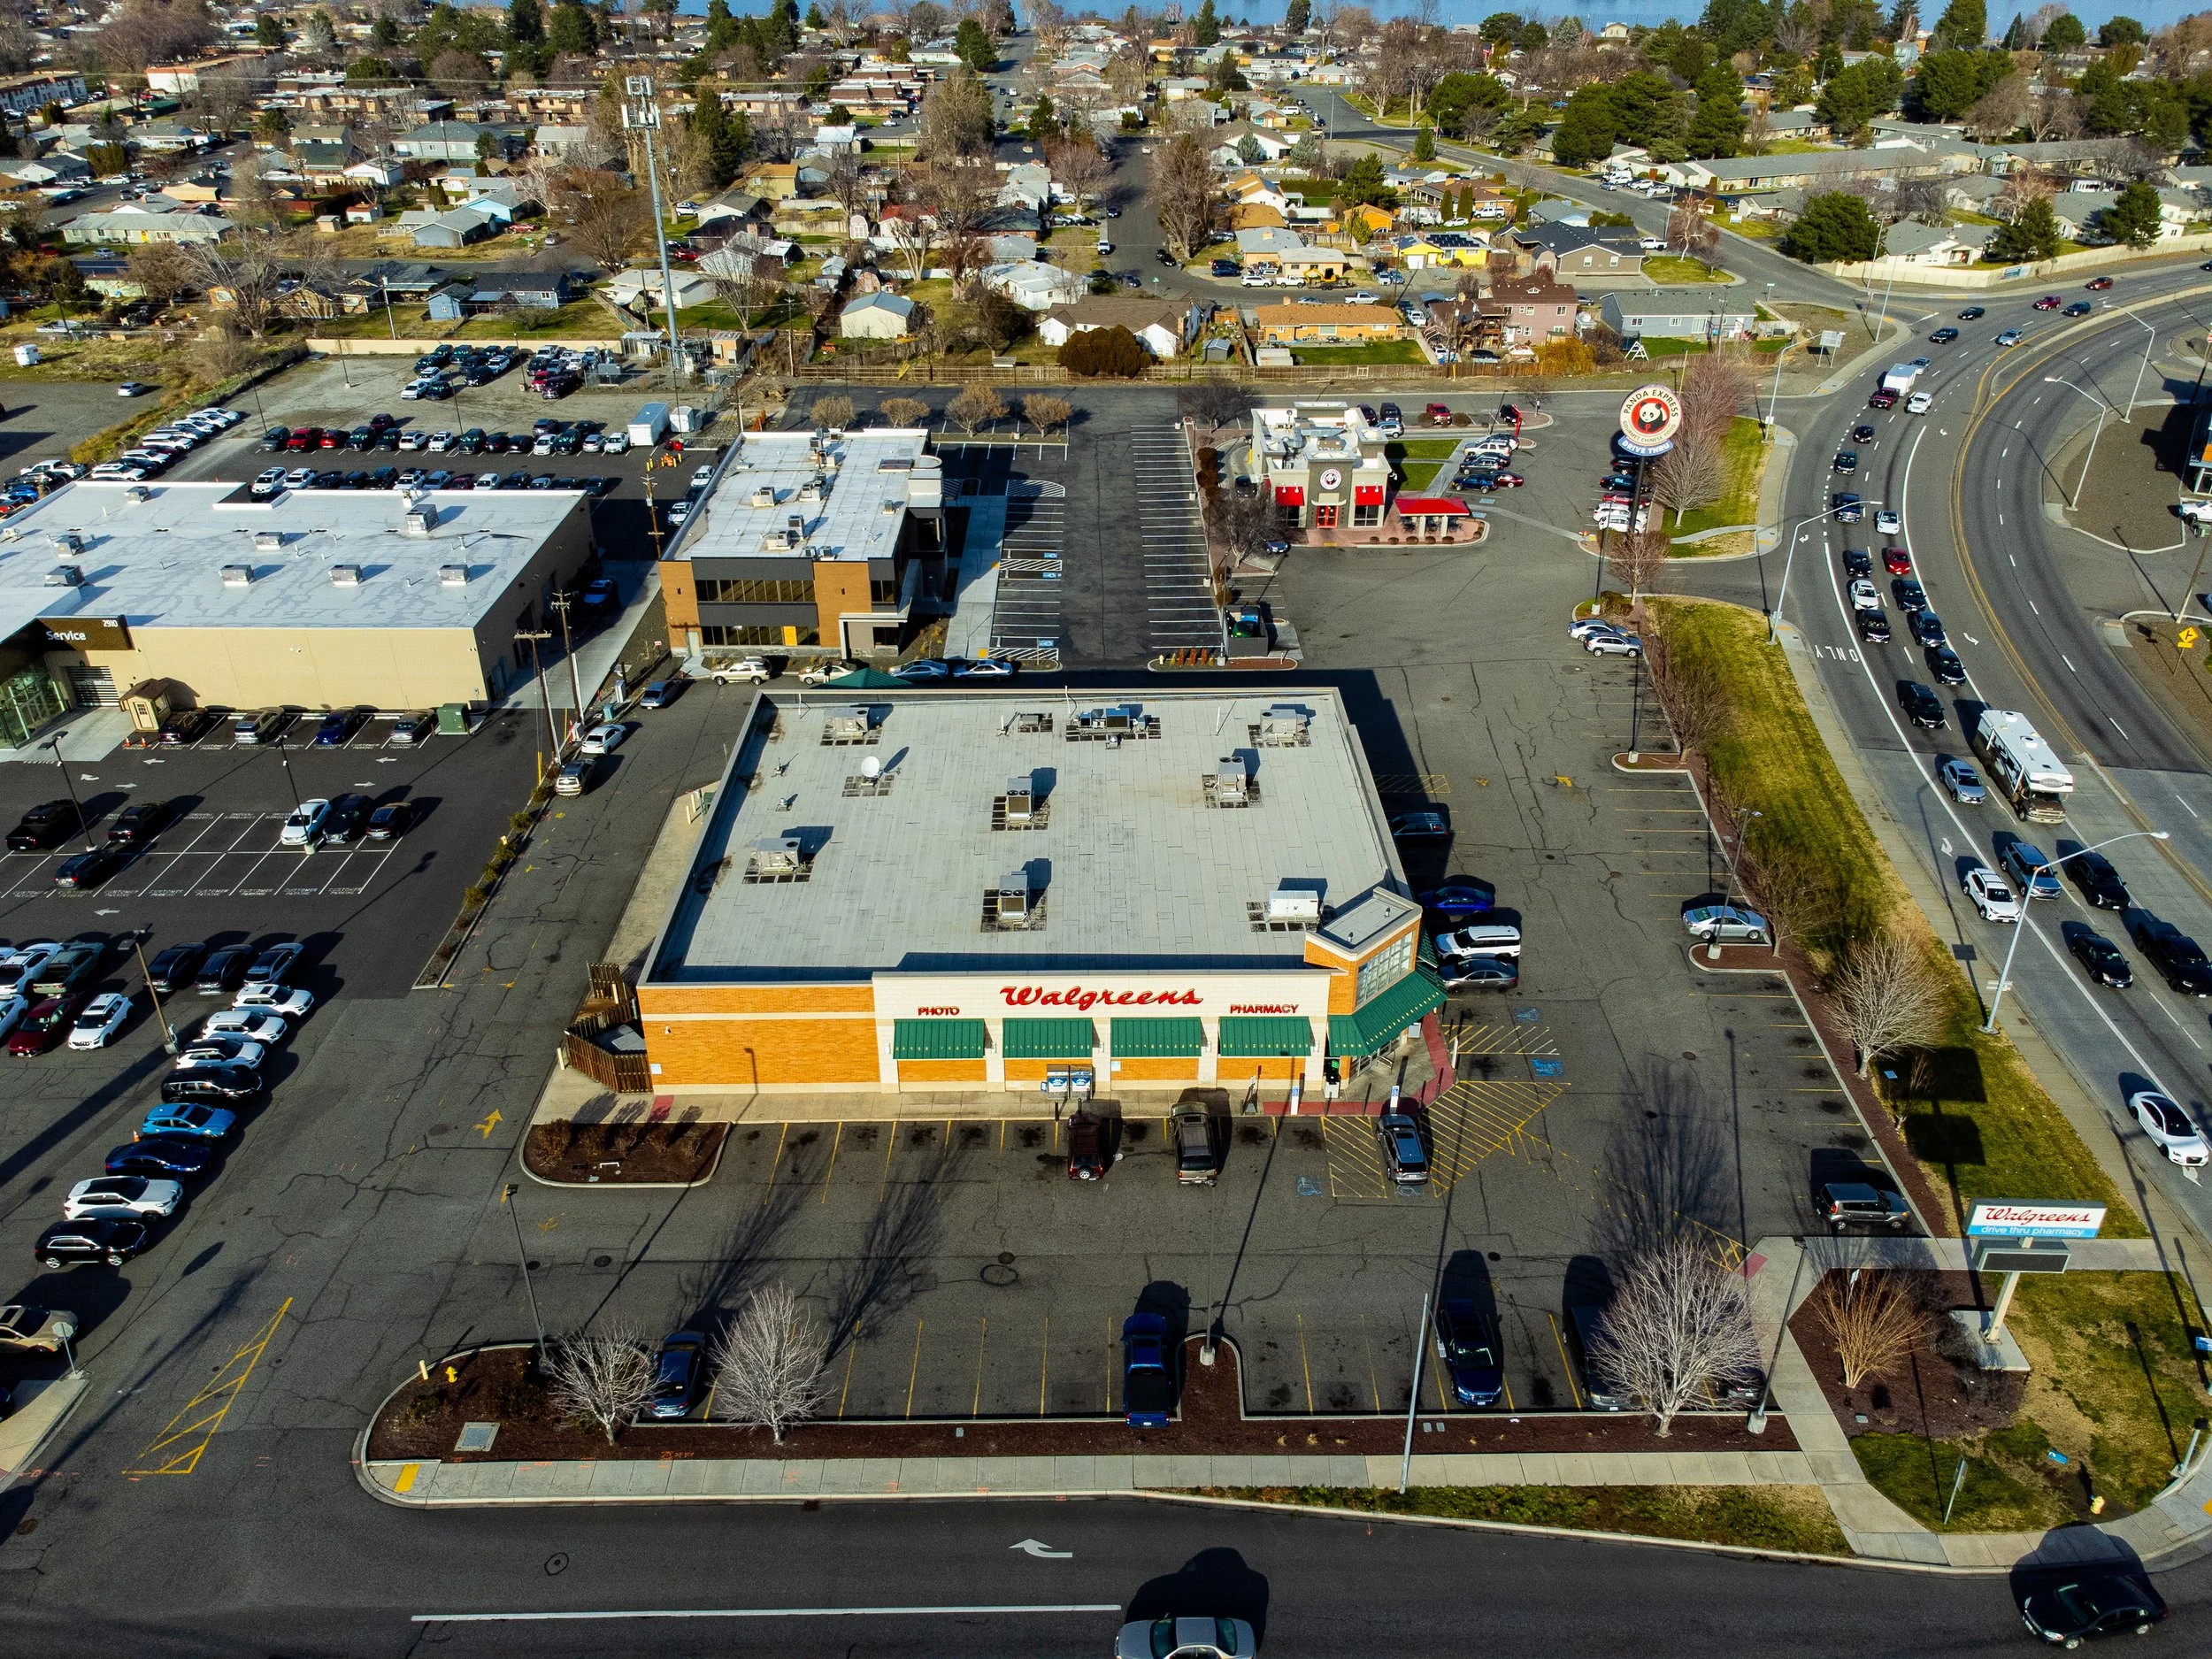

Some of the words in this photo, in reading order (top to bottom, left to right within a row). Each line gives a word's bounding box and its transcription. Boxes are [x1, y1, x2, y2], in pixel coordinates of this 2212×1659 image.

[1624, 390, 1648, 414] PANDA
[1652, 389, 1678, 418] EXPRESS
[1623, 420, 1640, 441] GOURMET
[1663, 423, 1676, 436] FOOD
[1622, 440, 1646, 454] DRIVE
[1648, 442, 1671, 454] THRU
[46, 630, 87, 641] Service
[1814, 644, 1859, 662] ONLY
[999, 985, 1204, 1012] Walgreens
[918, 1005, 960, 1017] PHOTO
[1229, 1002, 1299, 1015] PHARMACY
[1985, 1207, 2091, 1225] Walgreens
[2032, 1228, 2085, 1237] pharmacy
